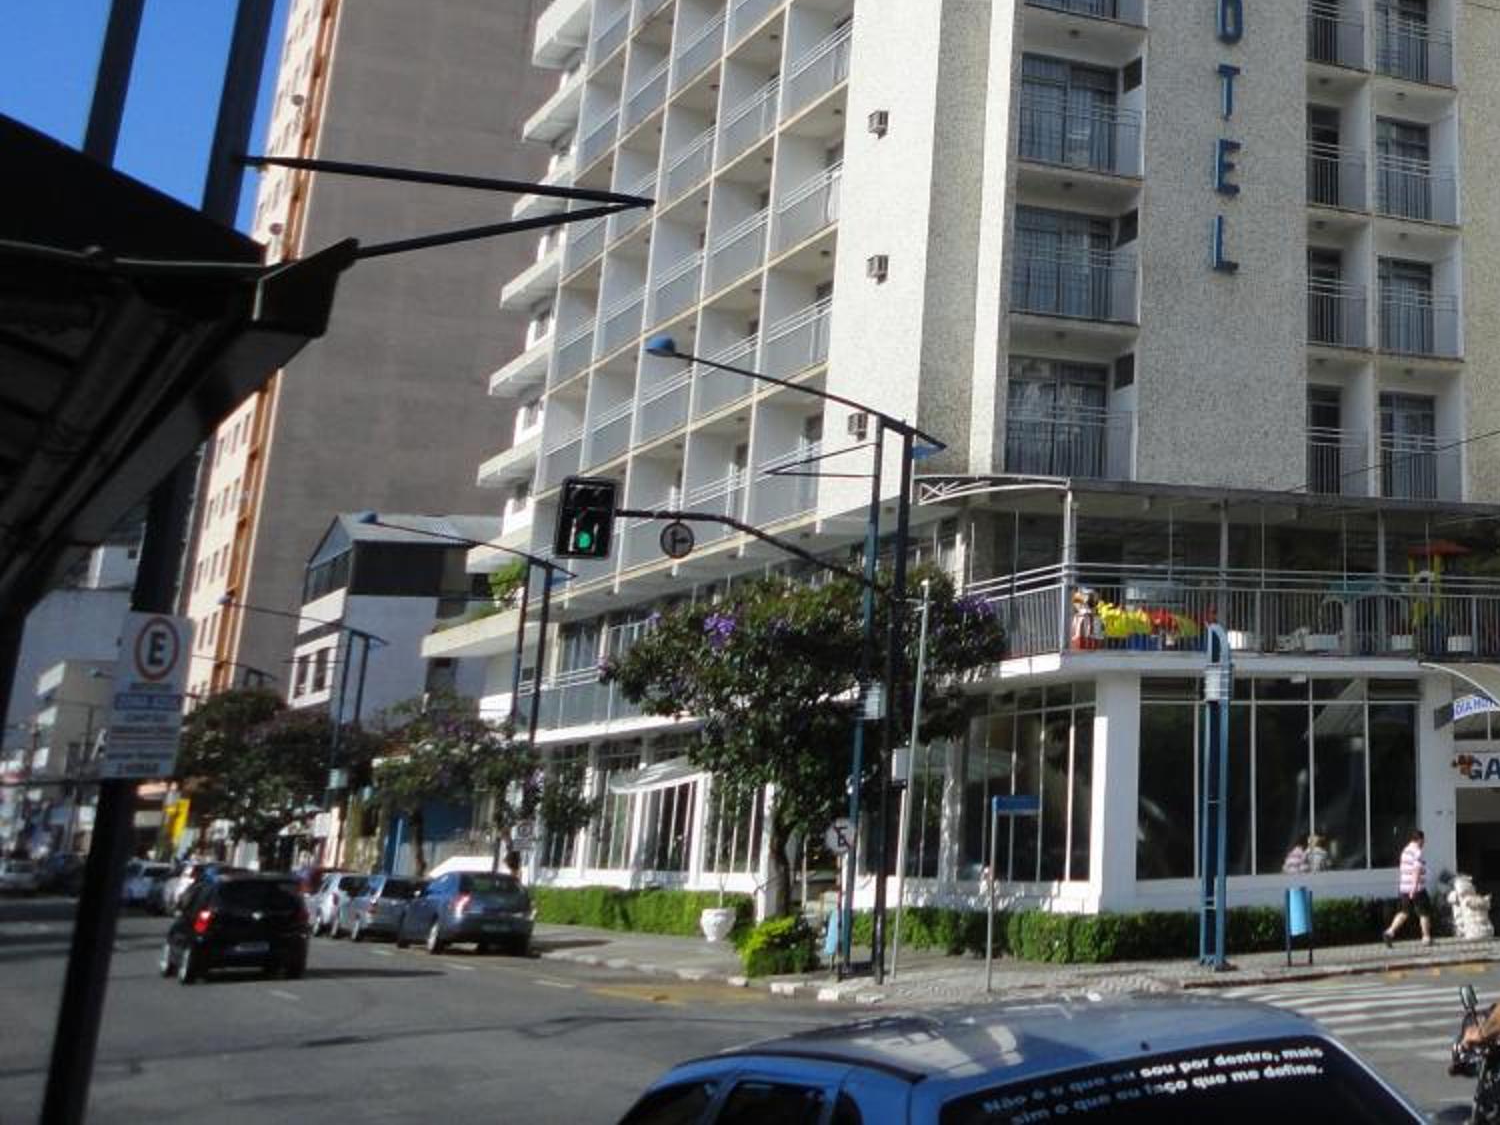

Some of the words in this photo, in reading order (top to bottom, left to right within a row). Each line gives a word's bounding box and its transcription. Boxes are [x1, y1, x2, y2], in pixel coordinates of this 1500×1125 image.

[147, 631, 166, 665] E
[1140, 1063, 1175, 1078] sou
[1179, 1057, 1210, 1074] por
[1214, 1050, 1280, 1068] dentro,
[1192, 1073, 1227, 1090] que
[1231, 1069, 1260, 1083] me
